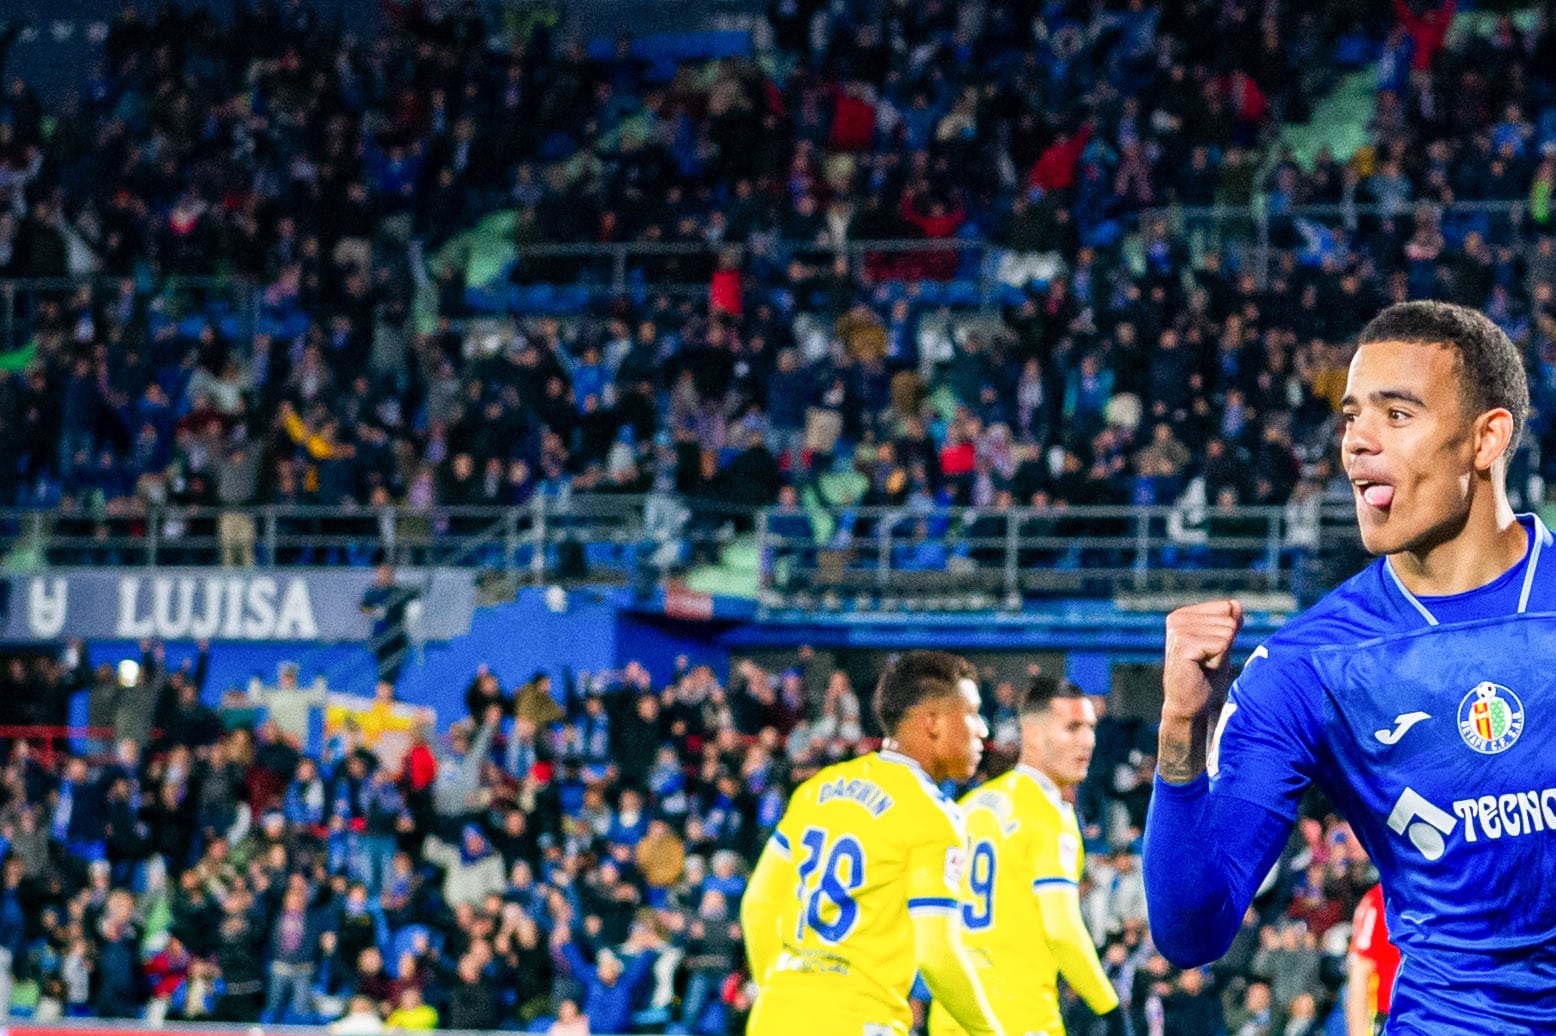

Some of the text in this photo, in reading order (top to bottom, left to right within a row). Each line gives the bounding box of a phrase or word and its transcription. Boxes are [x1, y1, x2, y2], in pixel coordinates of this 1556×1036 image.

[117, 576, 318, 638] LUJISA
[797, 827, 868, 943] 18
[963, 837, 996, 931] 9
